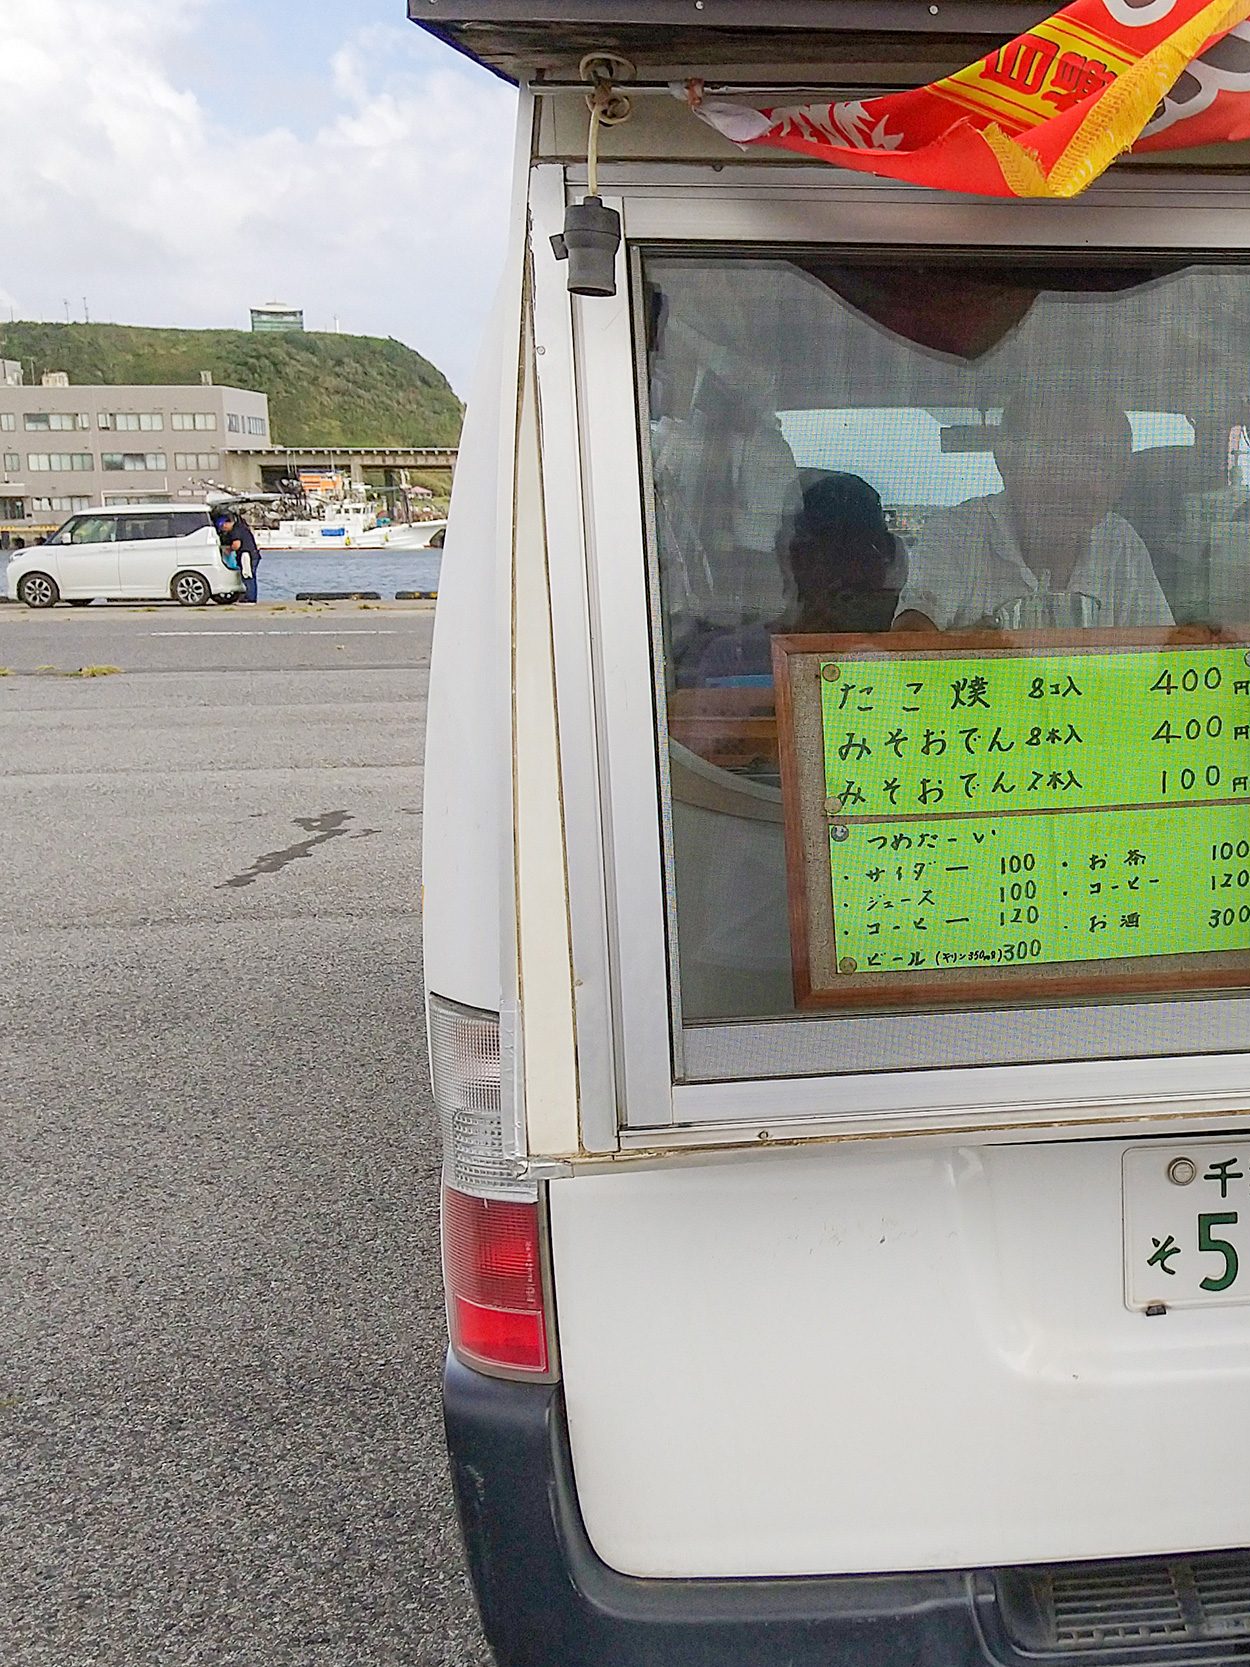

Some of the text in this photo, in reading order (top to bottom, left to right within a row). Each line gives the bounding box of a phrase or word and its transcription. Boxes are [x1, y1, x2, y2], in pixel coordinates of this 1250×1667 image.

[838, 727, 1014, 761] みそおでん
[838, 771, 1016, 807] みそおでん
[865, 853, 1036, 882] サイダー 100
[1089, 840, 1250, 870] お茶 100
[1210, 869, 1250, 891] 120
[866, 880, 1037, 911] ジュース 100
[1000, 905, 1040, 926] 120
[1088, 905, 1250, 933] お酒 300
[867, 951, 926, 967] ビール
[1002, 939, 1042, 962] 300
[1147, 1234, 1182, 1276] そ
